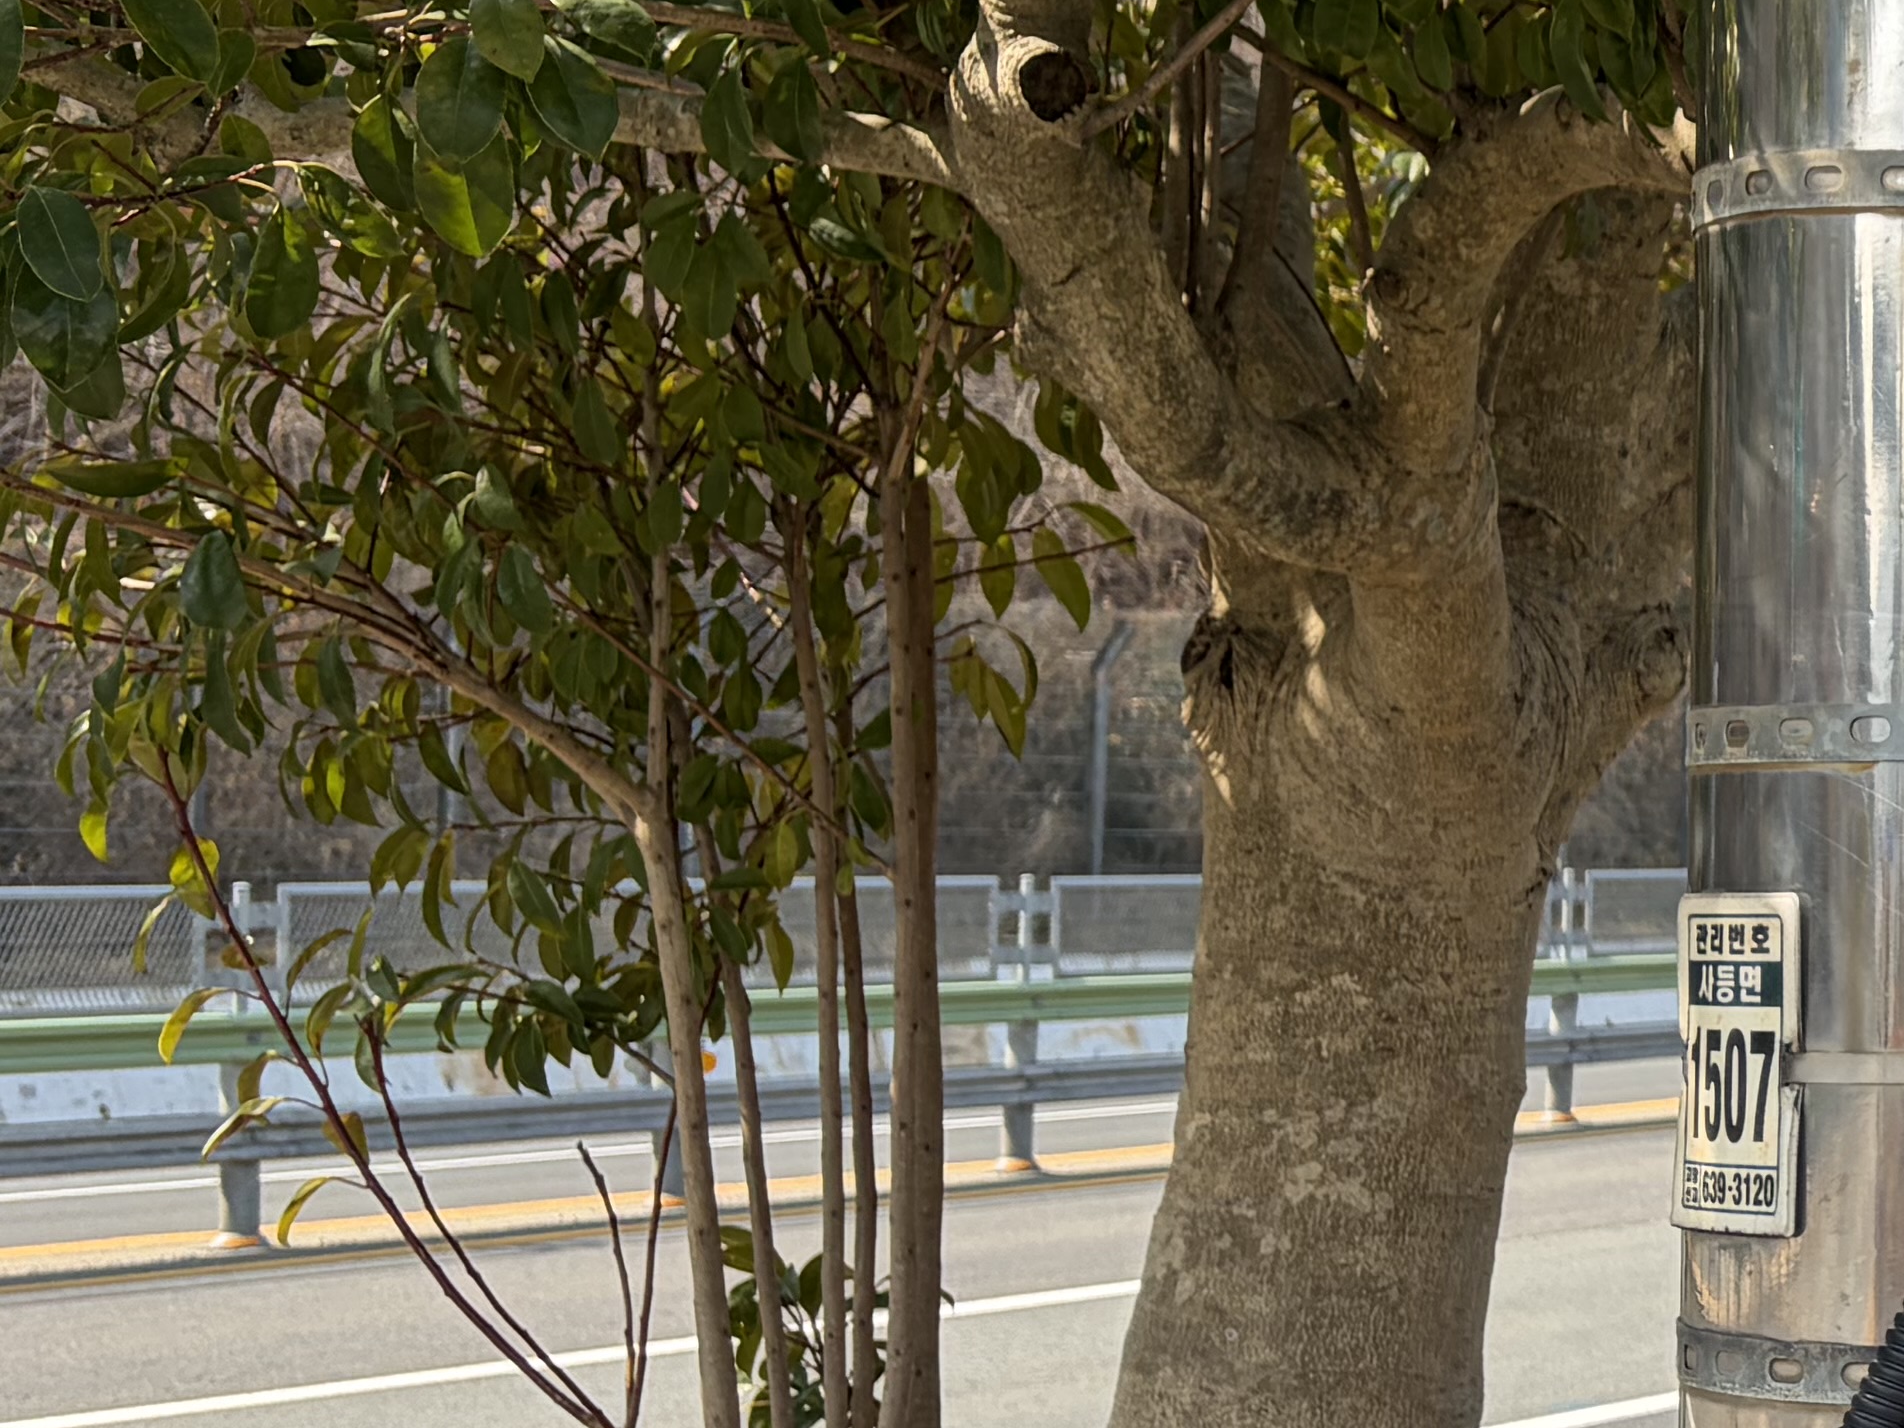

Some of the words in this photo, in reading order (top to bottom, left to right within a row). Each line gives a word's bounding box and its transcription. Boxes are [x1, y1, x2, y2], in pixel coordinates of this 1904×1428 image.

[1696, 922, 1770, 955] 관리번호
[1698, 963, 1762, 1003] 사등면
[1691, 1025, 1775, 1143] 1507
